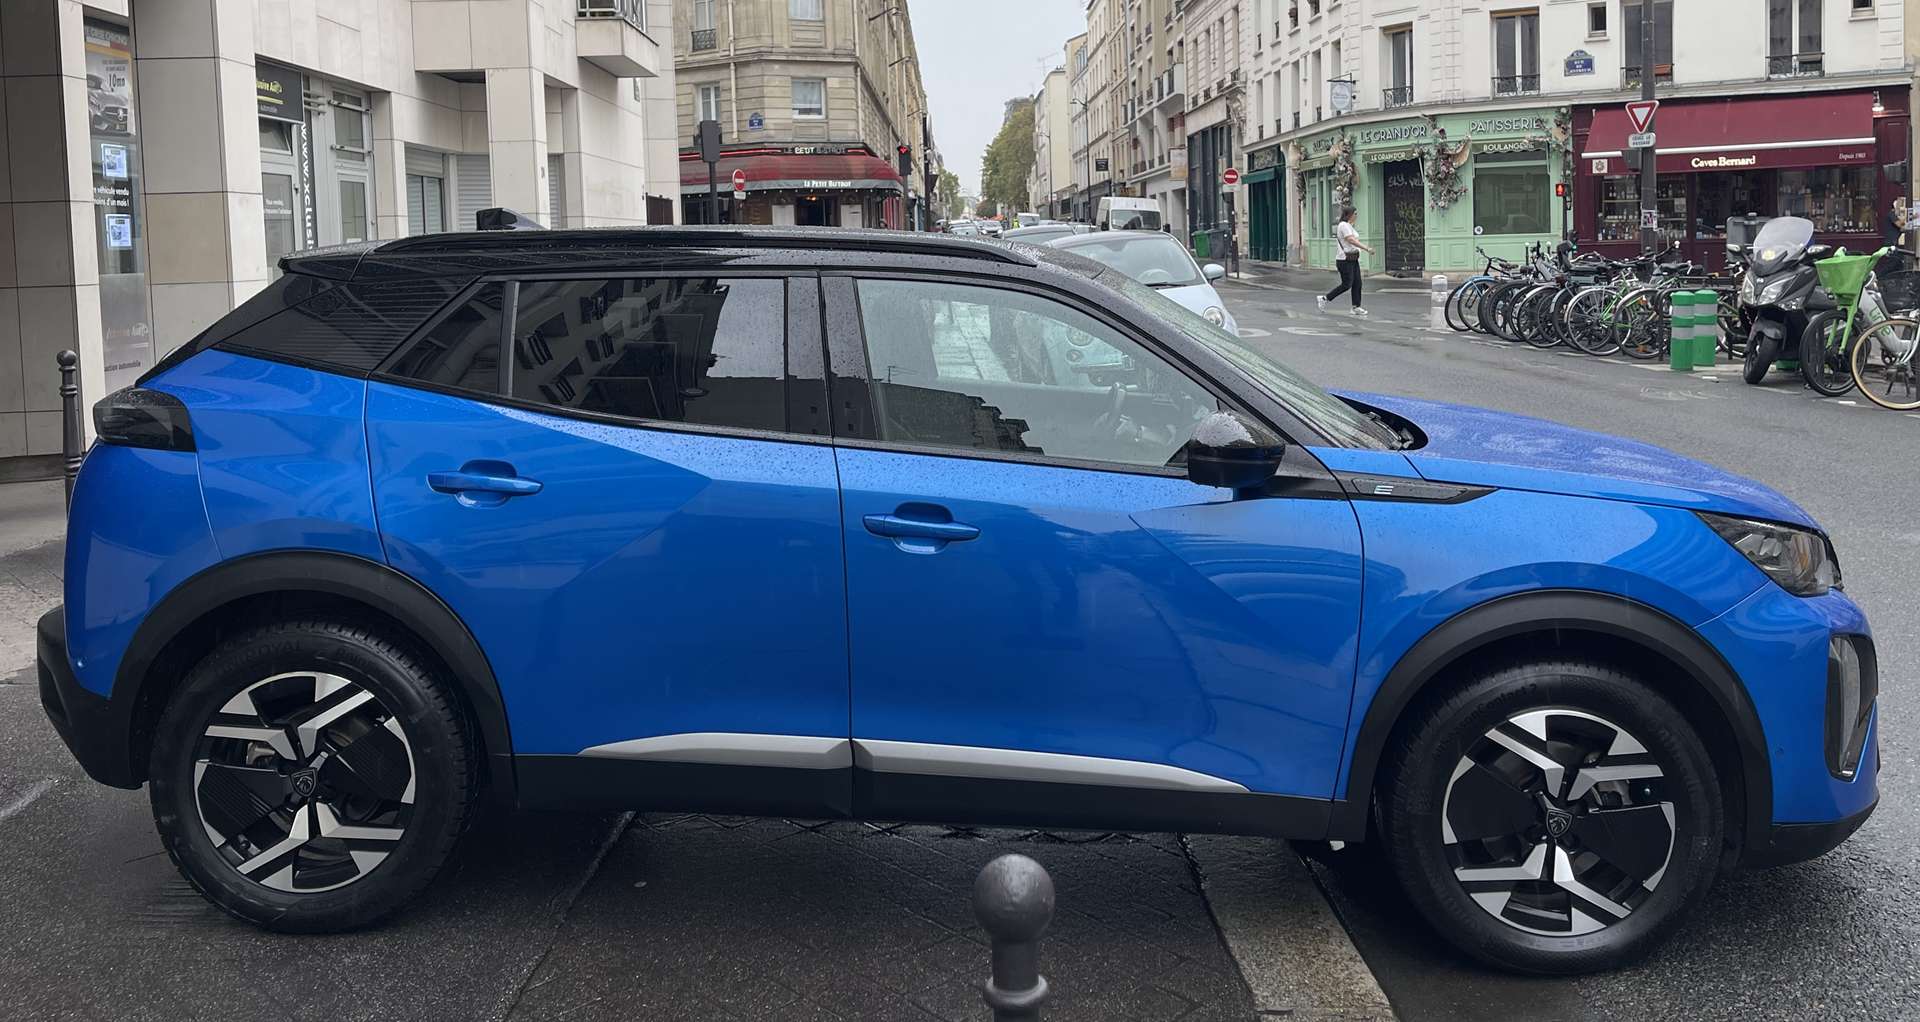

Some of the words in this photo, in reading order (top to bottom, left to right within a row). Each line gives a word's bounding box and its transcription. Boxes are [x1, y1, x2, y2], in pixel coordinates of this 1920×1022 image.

[1360, 130, 1372, 143] LE
[1403, 124, 1427, 139] D'OR
[1470, 117, 1542, 133] PATISSERIE
[1691, 157, 1718, 168] Caves
[1718, 155, 1756, 167] Bernard
[301, 122, 314, 250] www.xclusi
[1869, 306, 1891, 337] Lie
